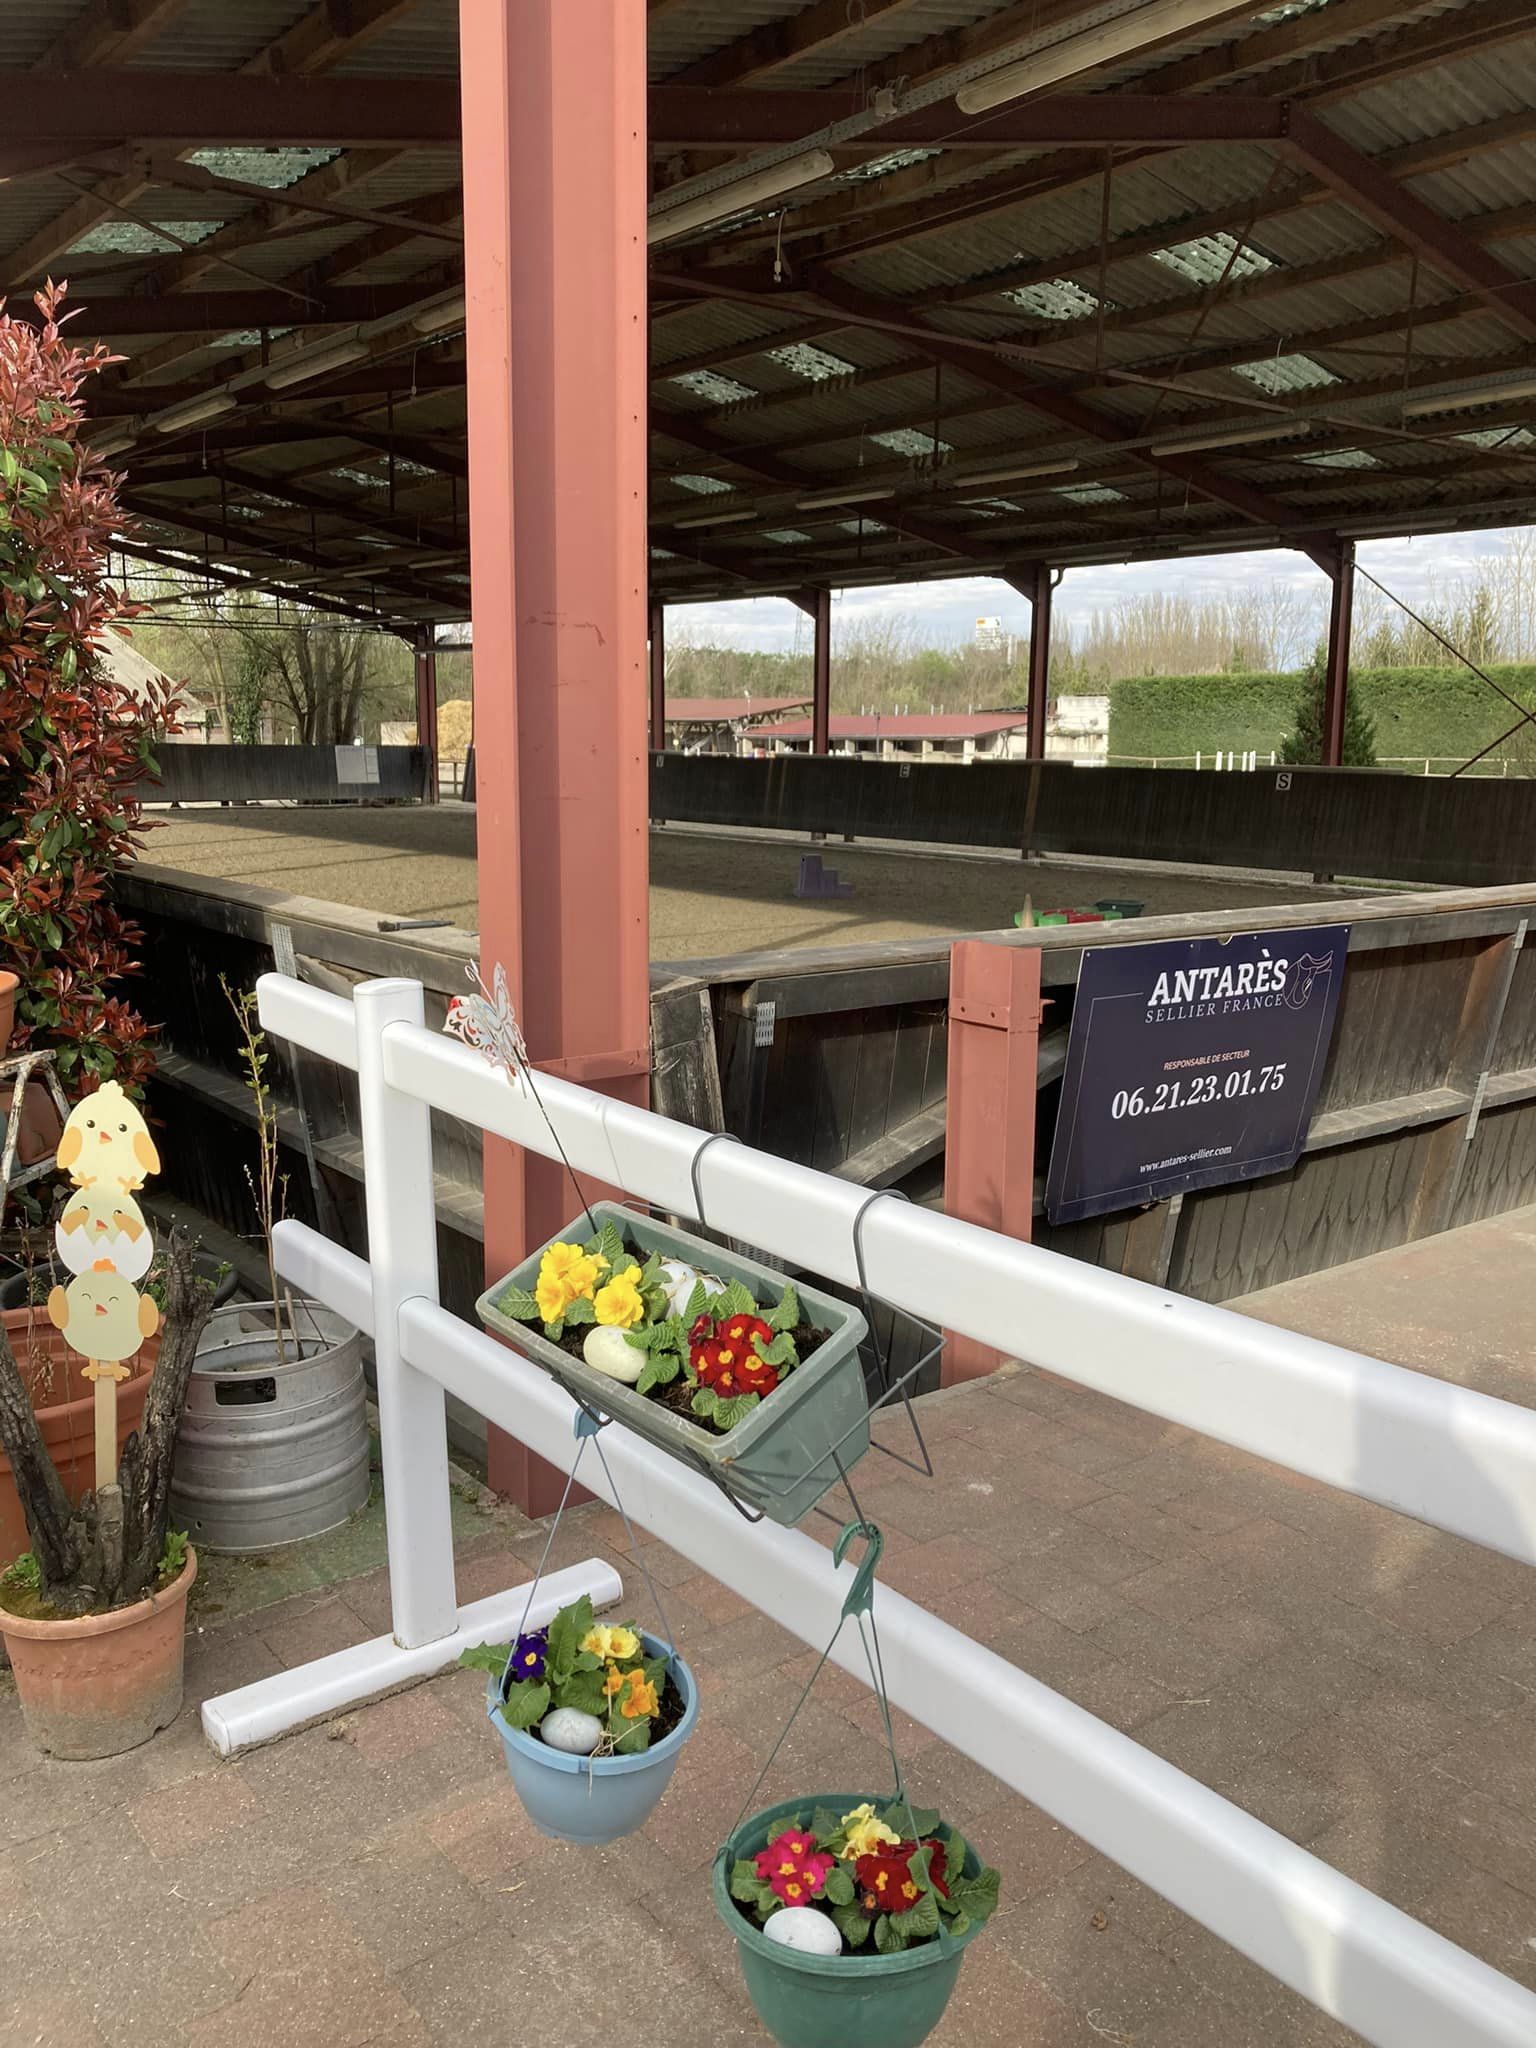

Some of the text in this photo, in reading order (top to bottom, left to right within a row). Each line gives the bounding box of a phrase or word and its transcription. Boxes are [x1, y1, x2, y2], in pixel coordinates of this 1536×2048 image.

[1278, 774, 1289, 789] S
[1147, 949, 1289, 1006] ANTARÈS
[1145, 993, 1283, 1024] SELLIER FRANCE
[1163, 1049, 1250, 1071] RESPONSABLE DE SECTEUR
[1111, 1062, 1287, 1120] 06.21.23.01.75
[1139, 1145, 1232, 1173] www.antares-sellier.com
